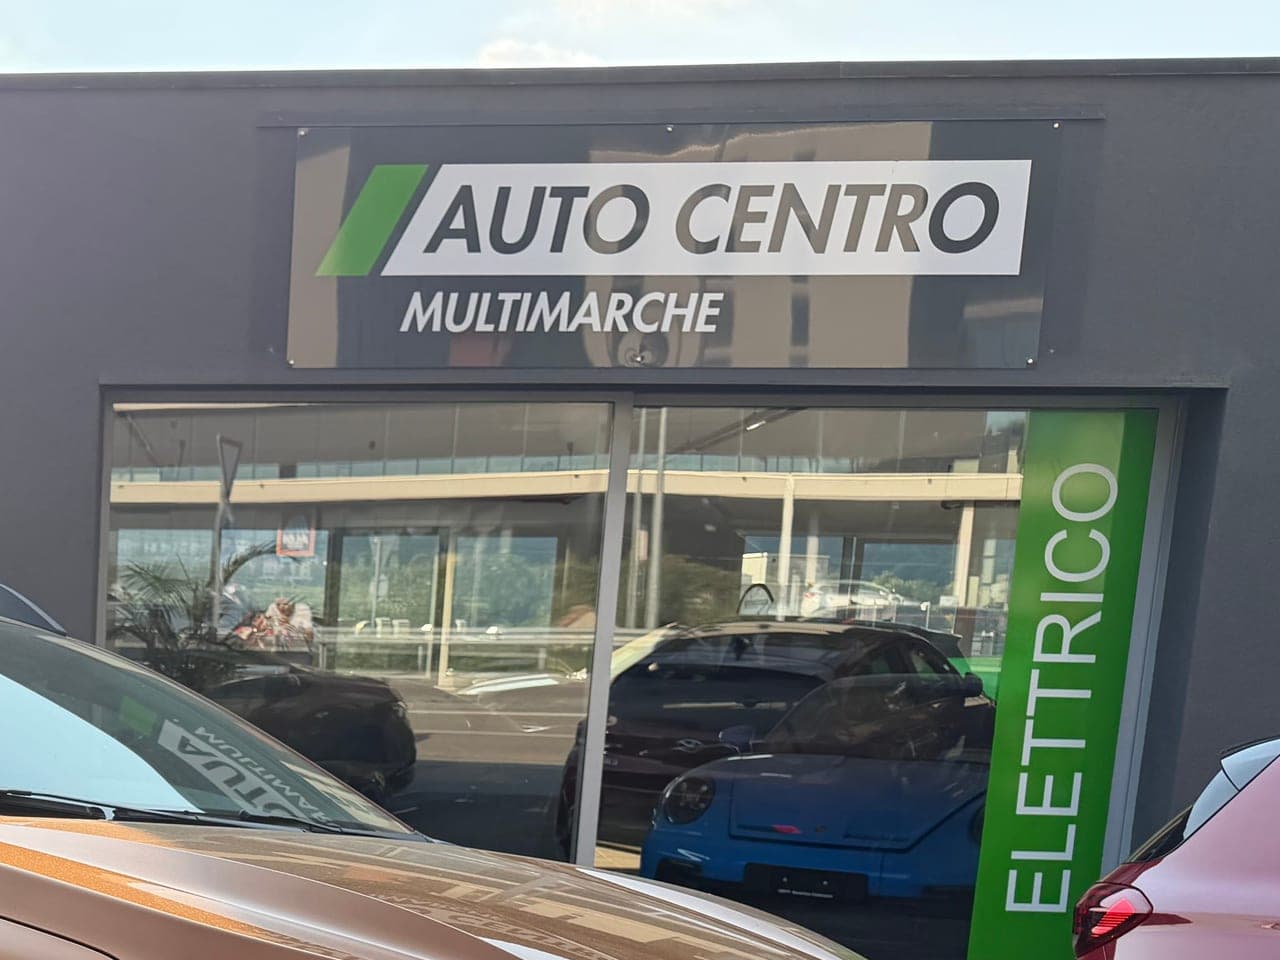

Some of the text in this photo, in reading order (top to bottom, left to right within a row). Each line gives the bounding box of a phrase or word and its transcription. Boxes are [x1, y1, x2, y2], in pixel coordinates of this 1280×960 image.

[423, 182, 999, 254] AUTO CENTRO
[400, 291, 724, 333] MULTIMARCHE
[1005, 462, 1118, 913] ELETTRICO
